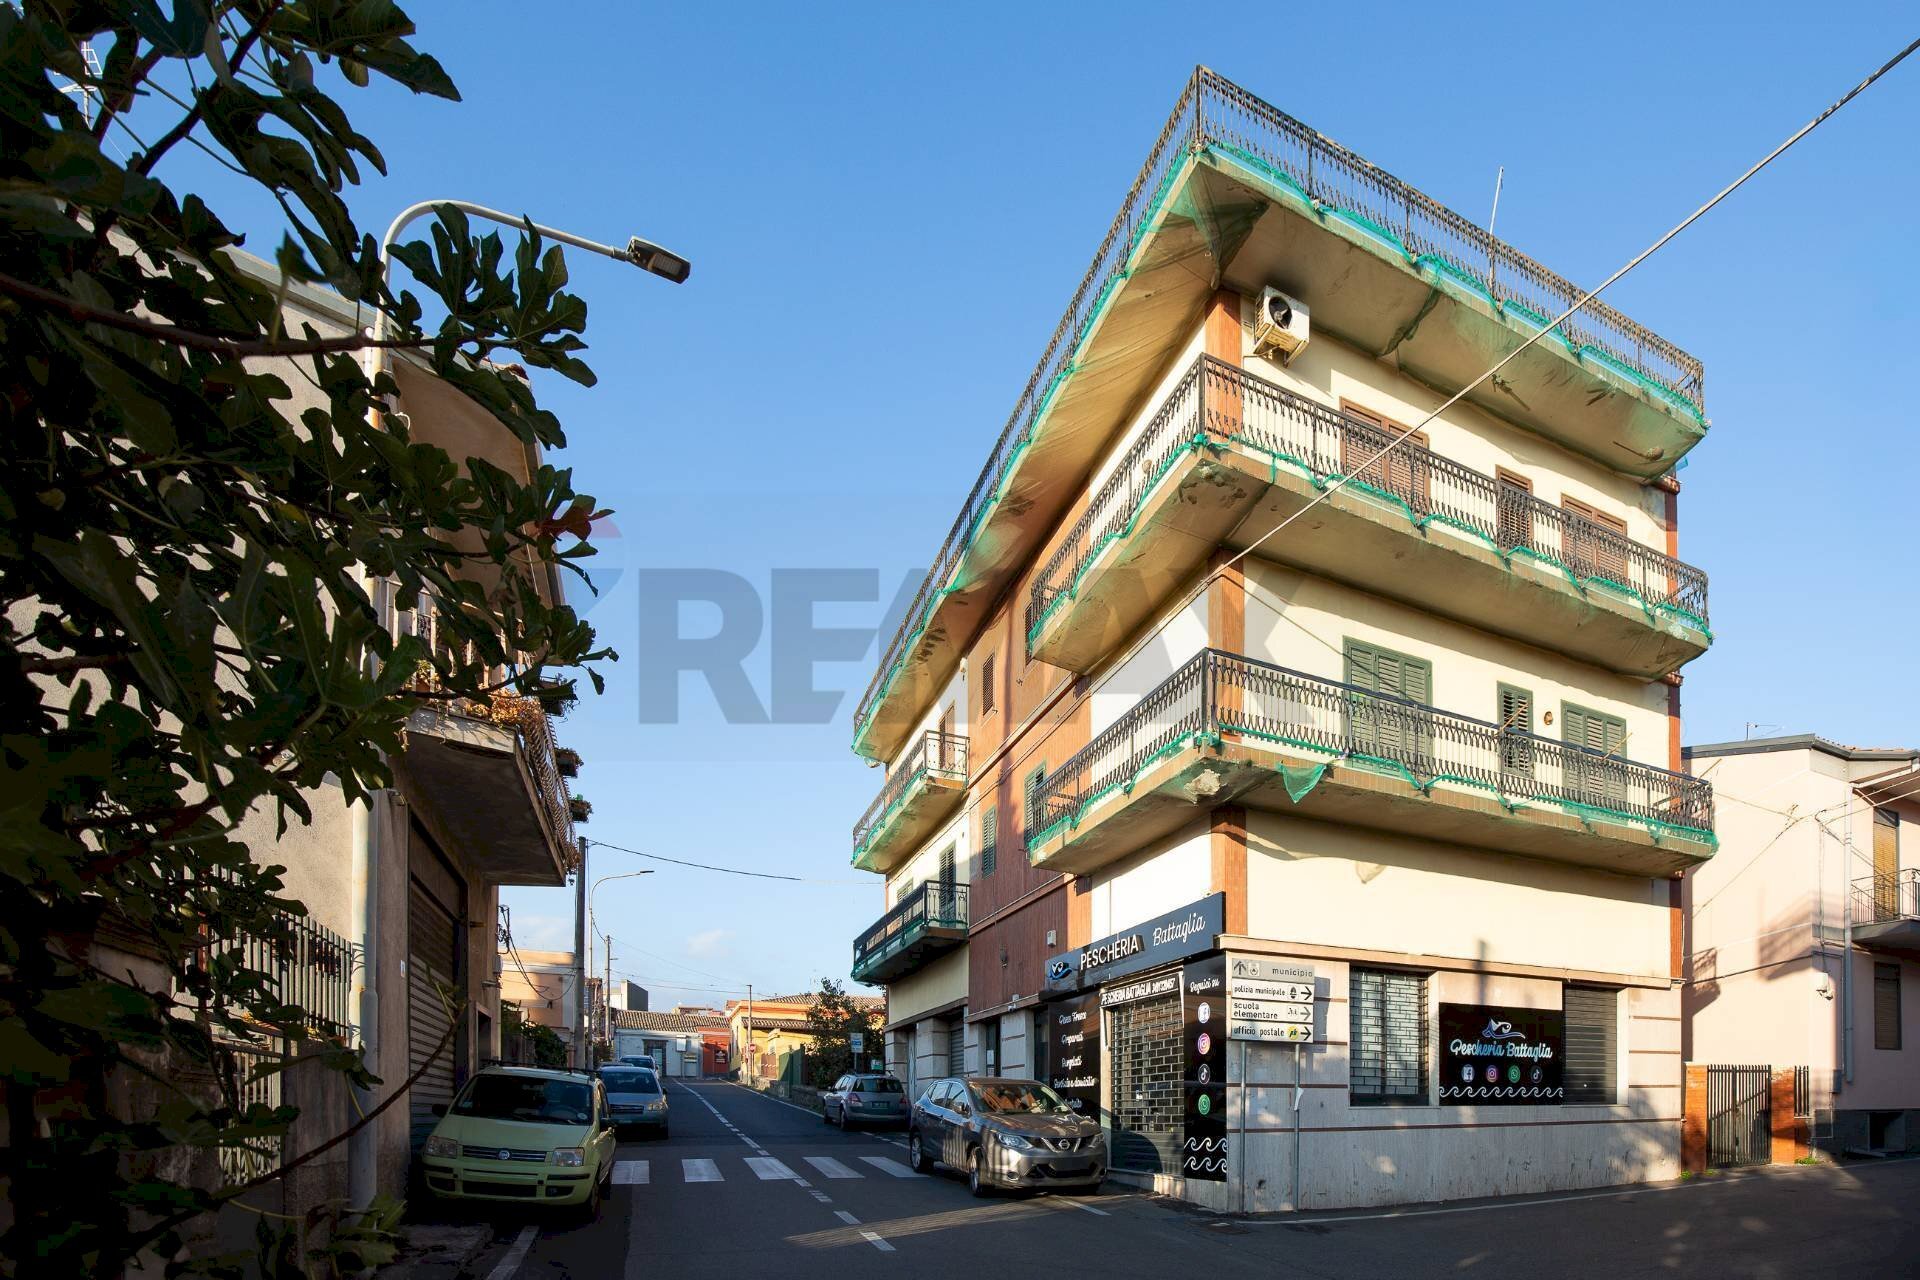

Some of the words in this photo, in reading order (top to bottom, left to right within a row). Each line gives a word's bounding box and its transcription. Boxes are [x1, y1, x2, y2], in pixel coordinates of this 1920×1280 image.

[1080, 934, 1139, 971] PESCHERIA
[1152, 912, 1206, 947] Battaglia
[1272, 968, 1313, 977] municipio
[1234, 985, 1254, 993] polizia
[1255, 988, 1286, 996] municipale
[1233, 1002, 1260, 1010] scuola
[1233, 1010, 1278, 1019] elementare
[1233, 1026, 1256, 1035] ufficio
[1259, 1027, 1285, 1037] postale
[1450, 1038, 1505, 1056] Pescheria
[1506, 1040, 1553, 1062] Battaglia
